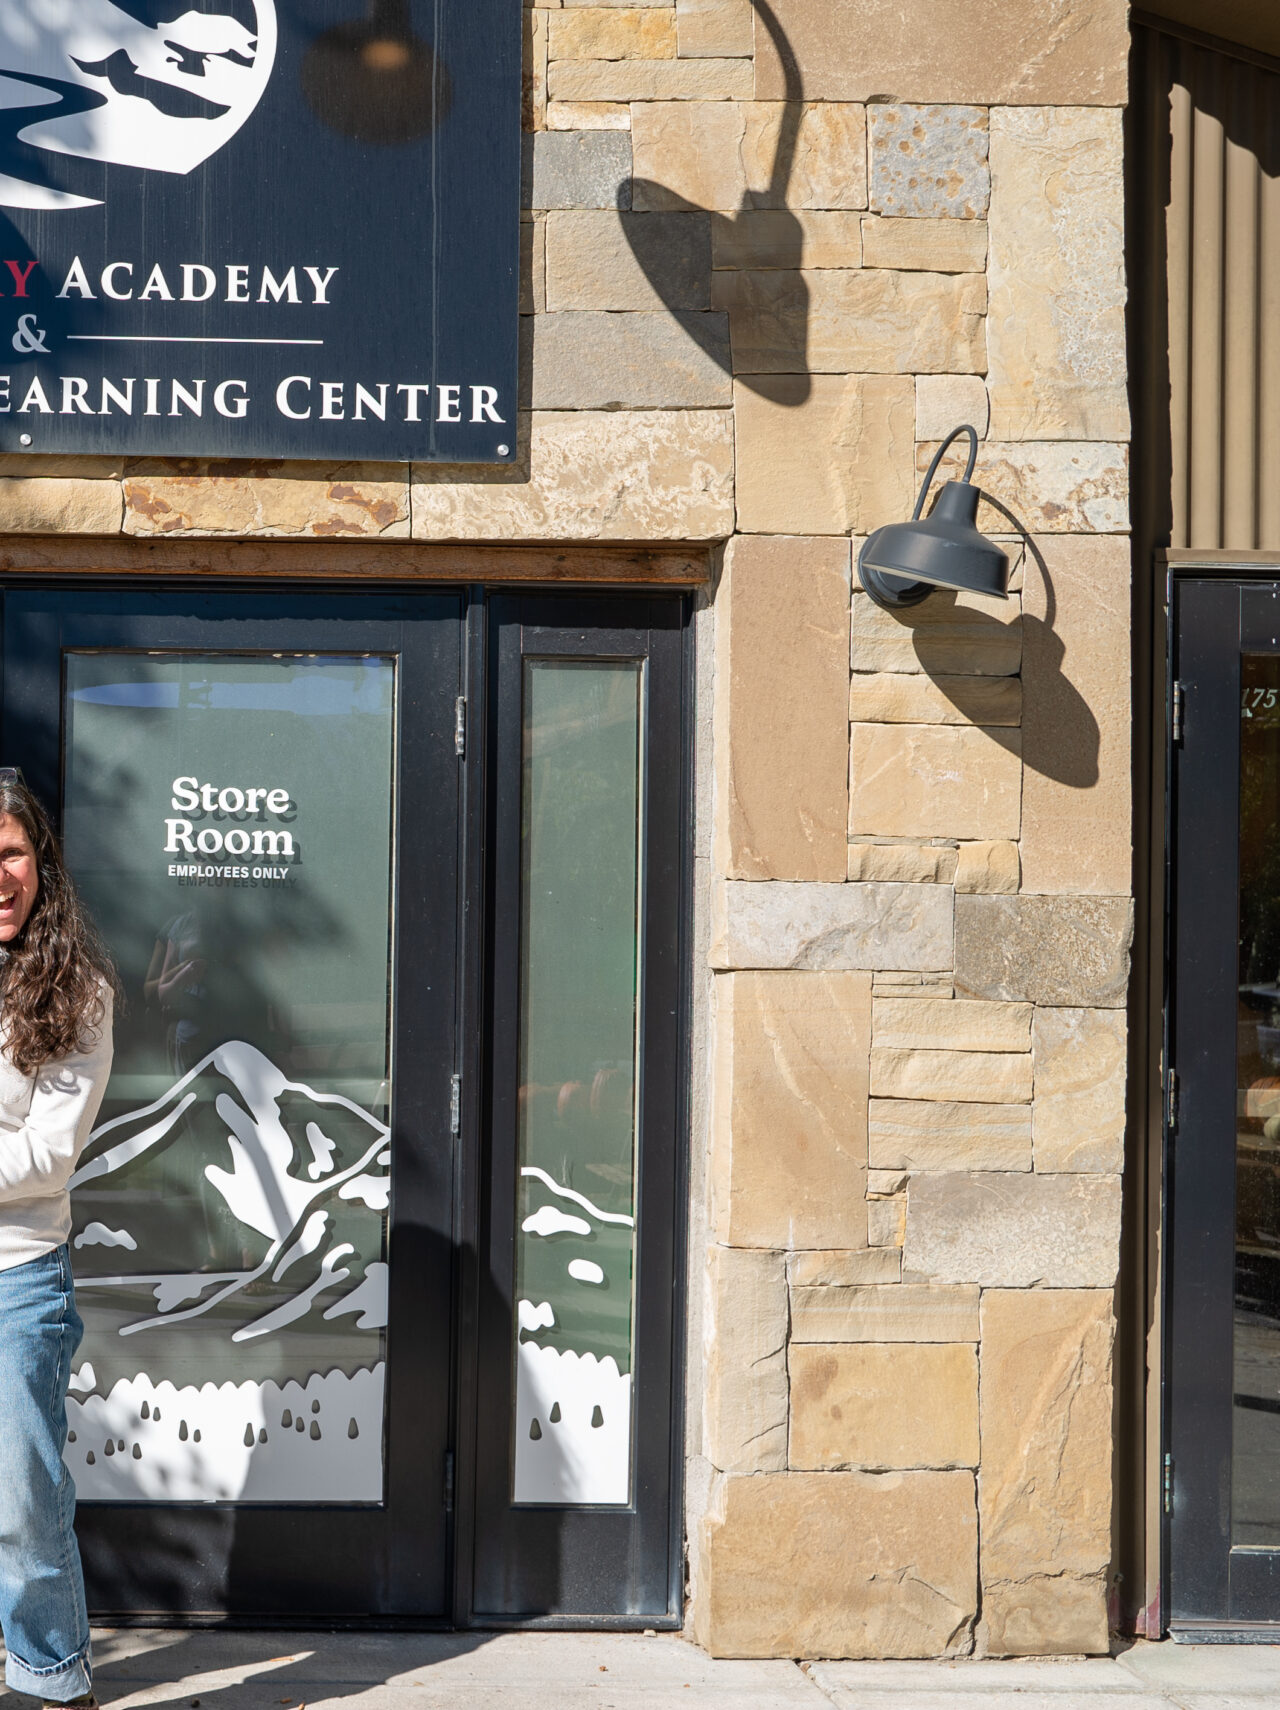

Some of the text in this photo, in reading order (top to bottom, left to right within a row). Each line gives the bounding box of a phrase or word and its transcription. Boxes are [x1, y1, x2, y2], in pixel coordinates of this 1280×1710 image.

[55, 254, 342, 306] ACADEMY
[11, 312, 52, 355] &
[273, 374, 508, 424] CENTER
[171, 776, 290, 813] Store
[163, 818, 296, 855] Room
[168, 864, 289, 880] EMPLOYEES ONLY
